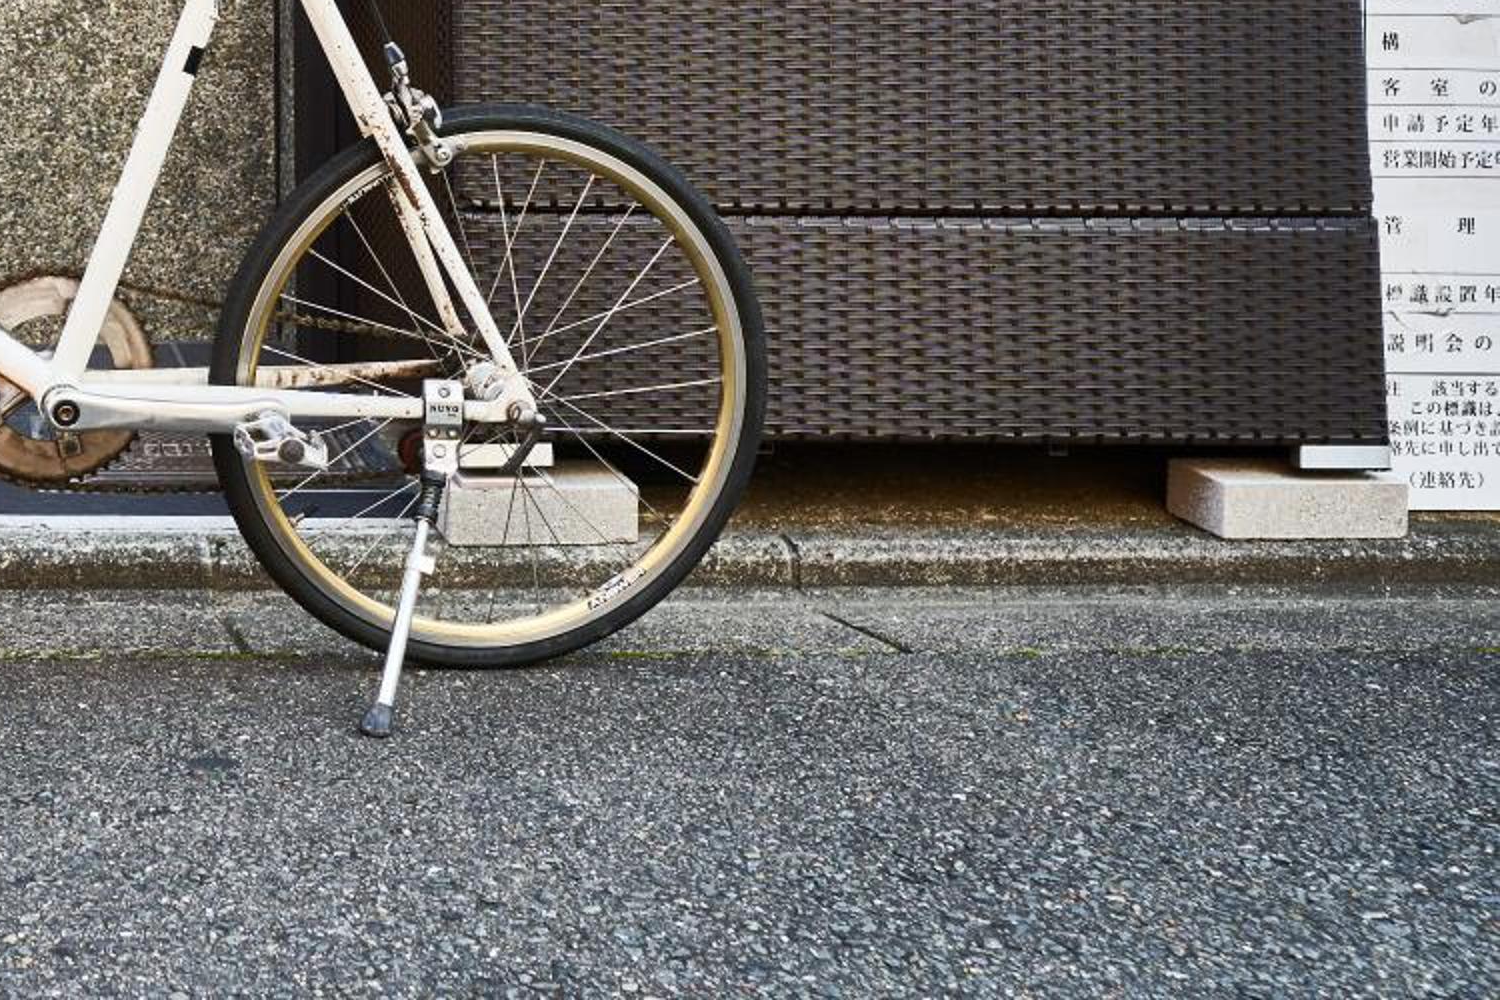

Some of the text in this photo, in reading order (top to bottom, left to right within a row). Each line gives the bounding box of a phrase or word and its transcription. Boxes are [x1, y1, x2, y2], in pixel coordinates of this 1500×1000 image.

[1382, 31, 1399, 51] 構
[1382, 77, 1497, 97] 客室の
[1383, 113, 1499, 133] 申請予定年
[1385, 215, 1476, 235] 管理
[1386, 283, 1500, 304] 標識設置年
[1387, 333, 1493, 353] 説明会の
[1431, 381, 1498, 397] 該当する
